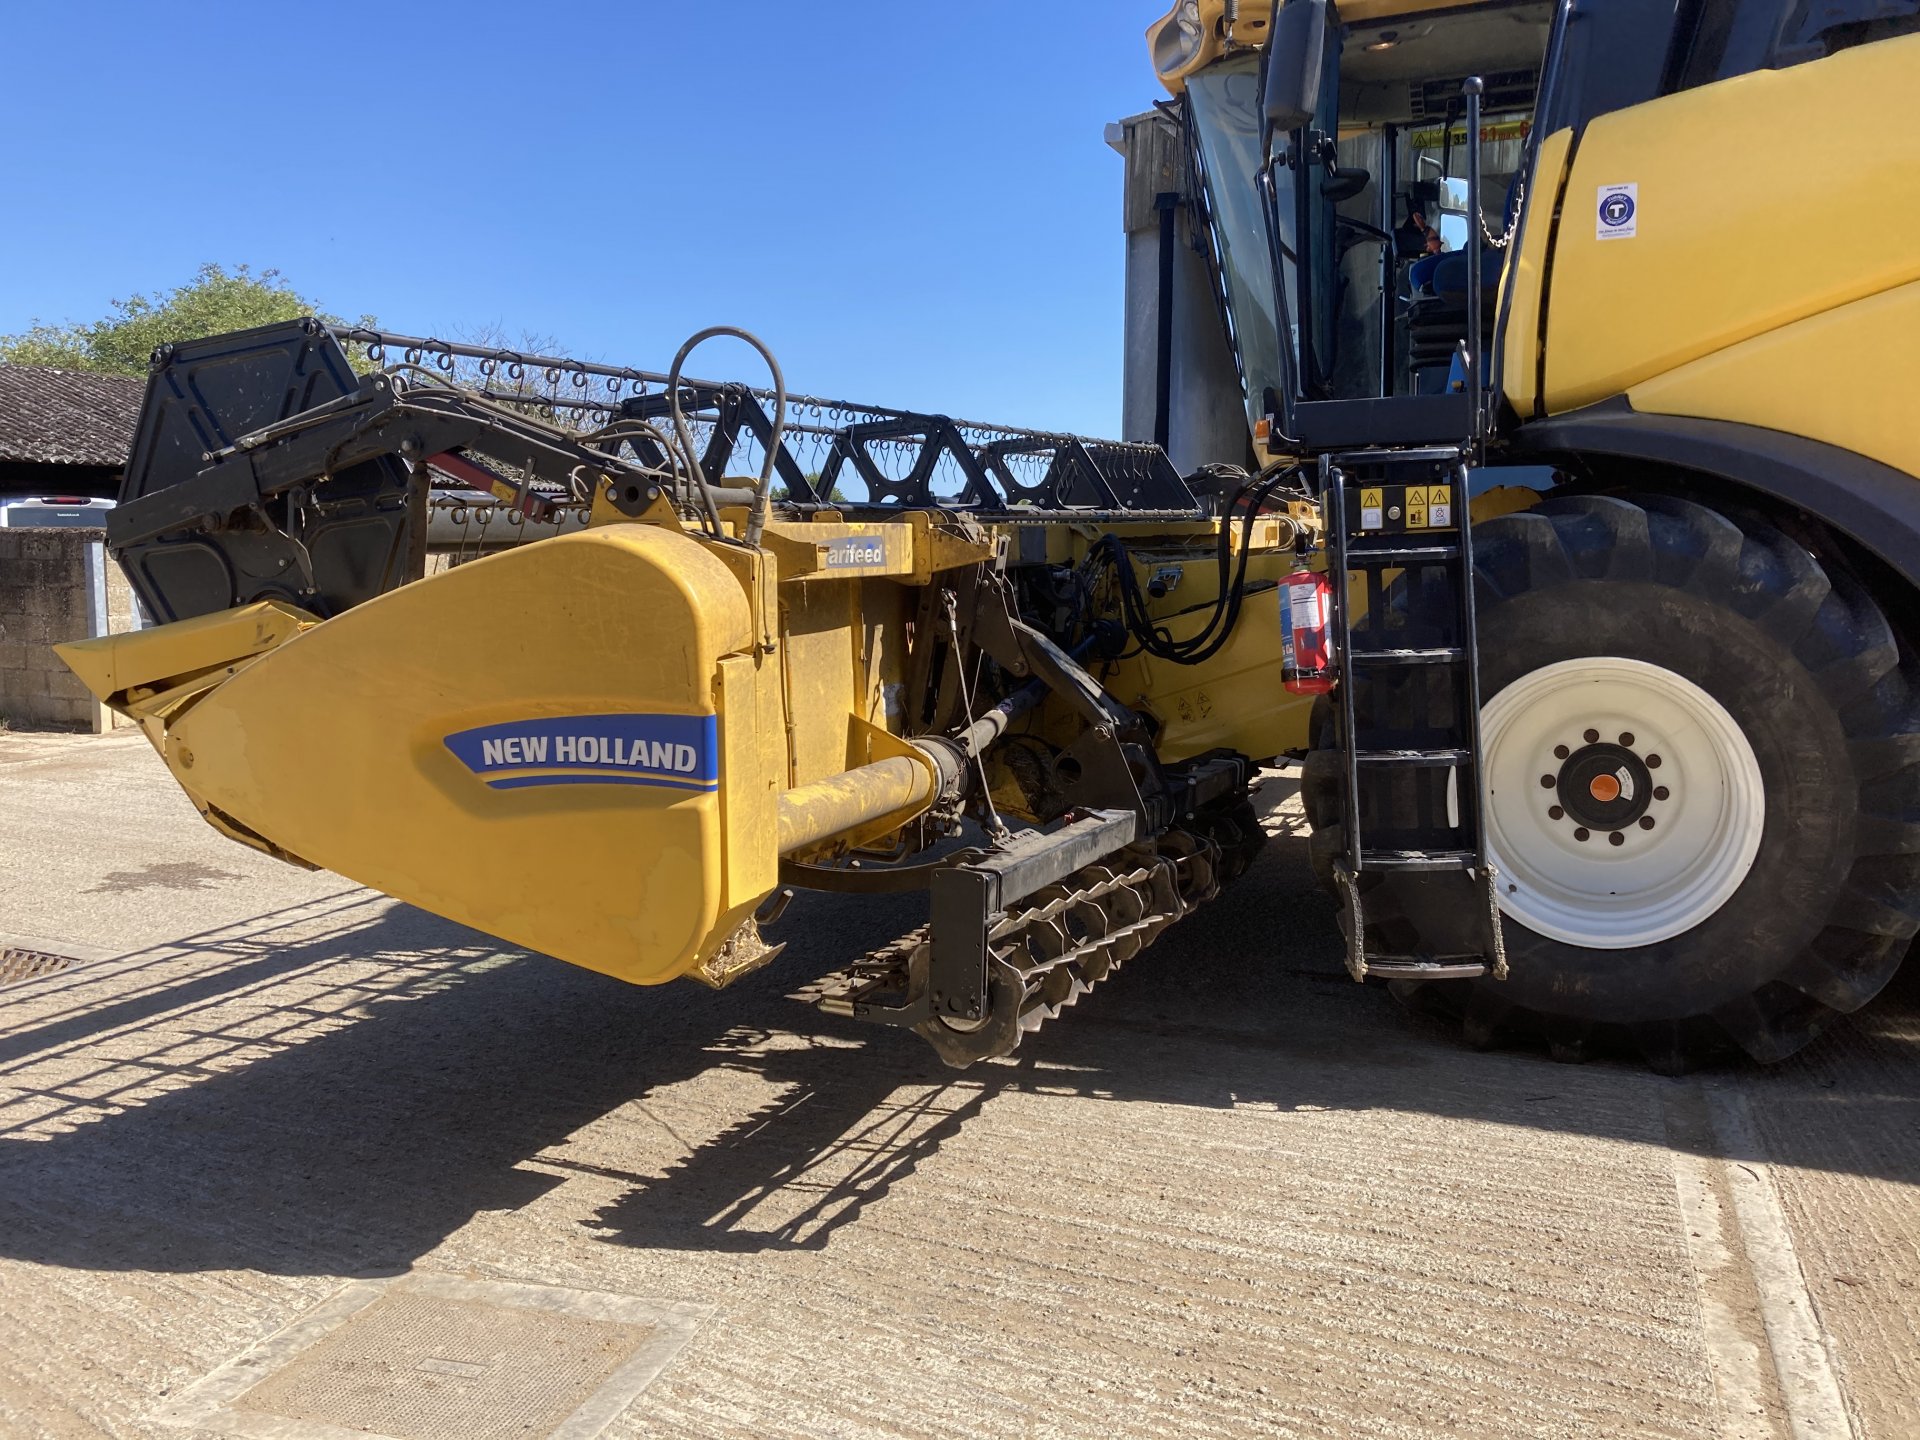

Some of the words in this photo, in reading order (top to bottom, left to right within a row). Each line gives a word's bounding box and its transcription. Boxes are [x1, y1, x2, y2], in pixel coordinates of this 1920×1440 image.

[1609, 204, 1625, 217] T
[827, 544, 883, 565] arifeed
[482, 736, 548, 766] NEW
[555, 736, 697, 773] HOLLAND
